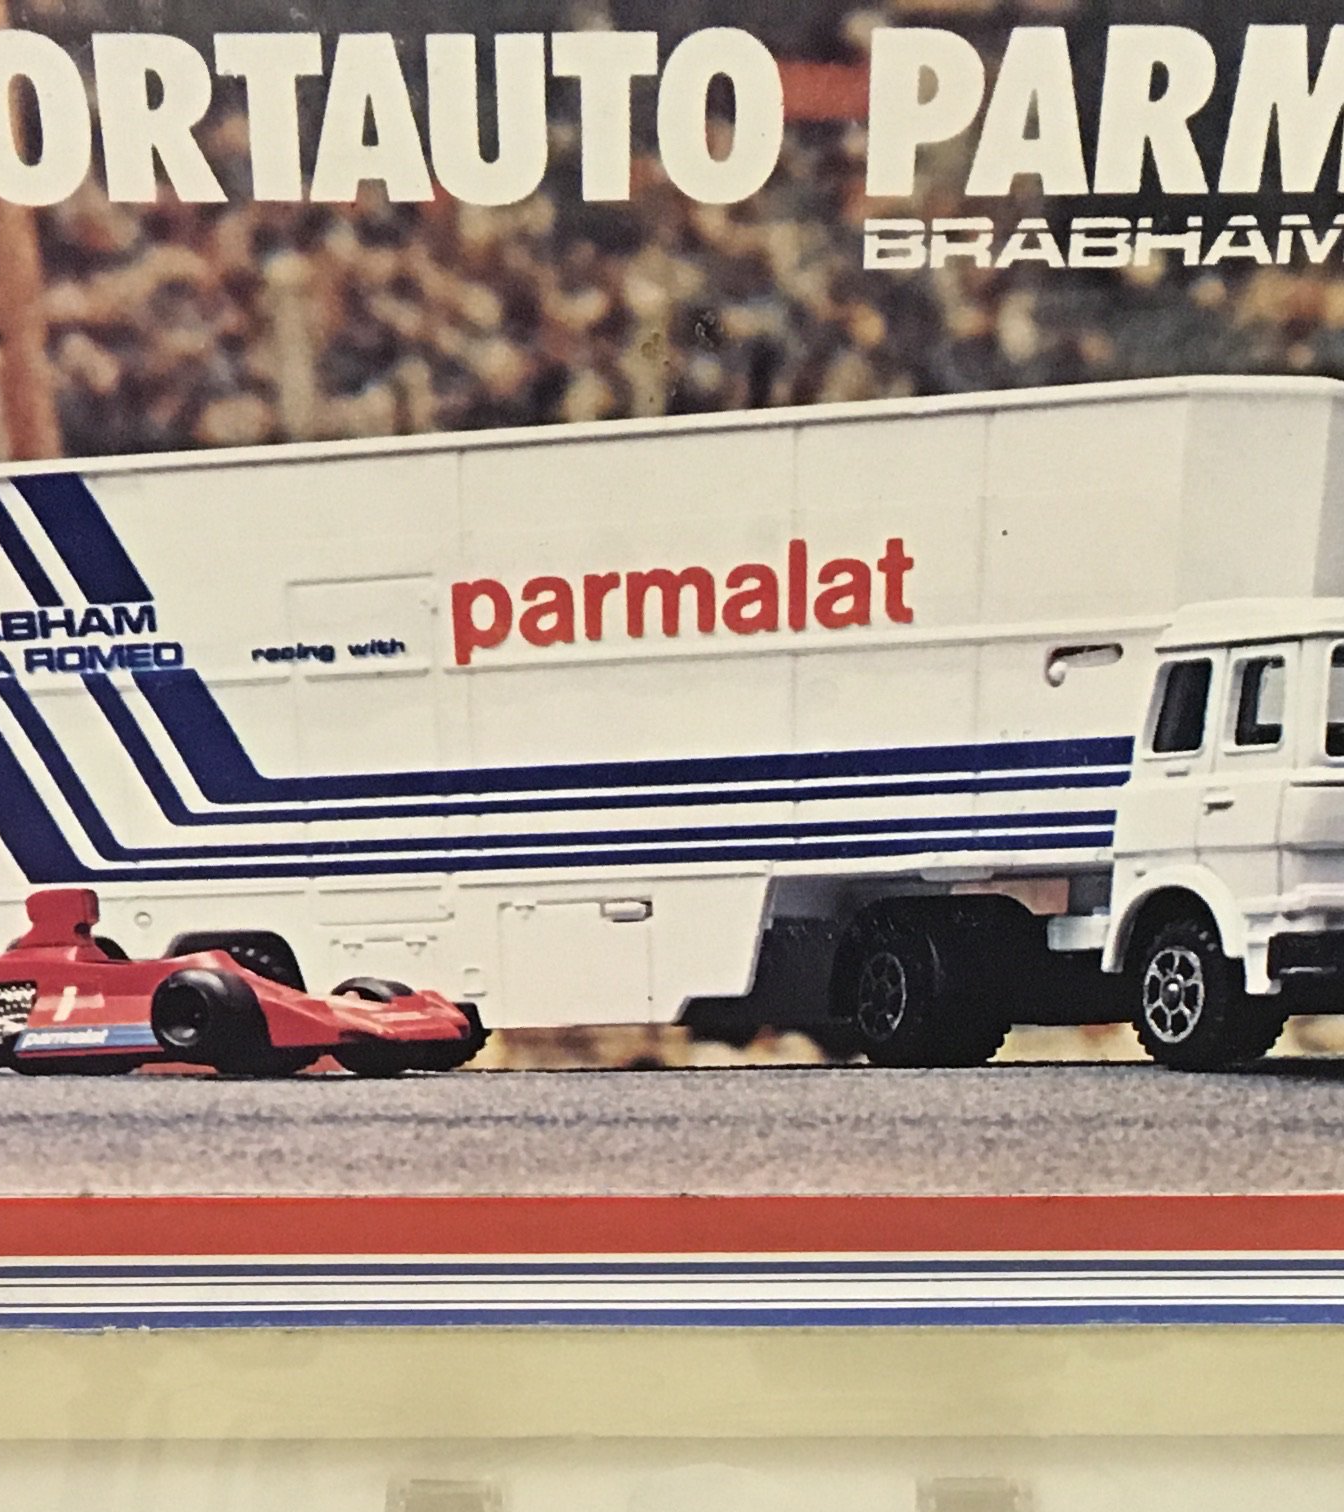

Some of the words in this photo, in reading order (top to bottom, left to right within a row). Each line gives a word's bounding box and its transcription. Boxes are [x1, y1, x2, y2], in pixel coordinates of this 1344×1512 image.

[452, 538, 914, 665] parmalat
[25, 642, 183, 674] ROMEO
[347, 637, 406, 656] with
